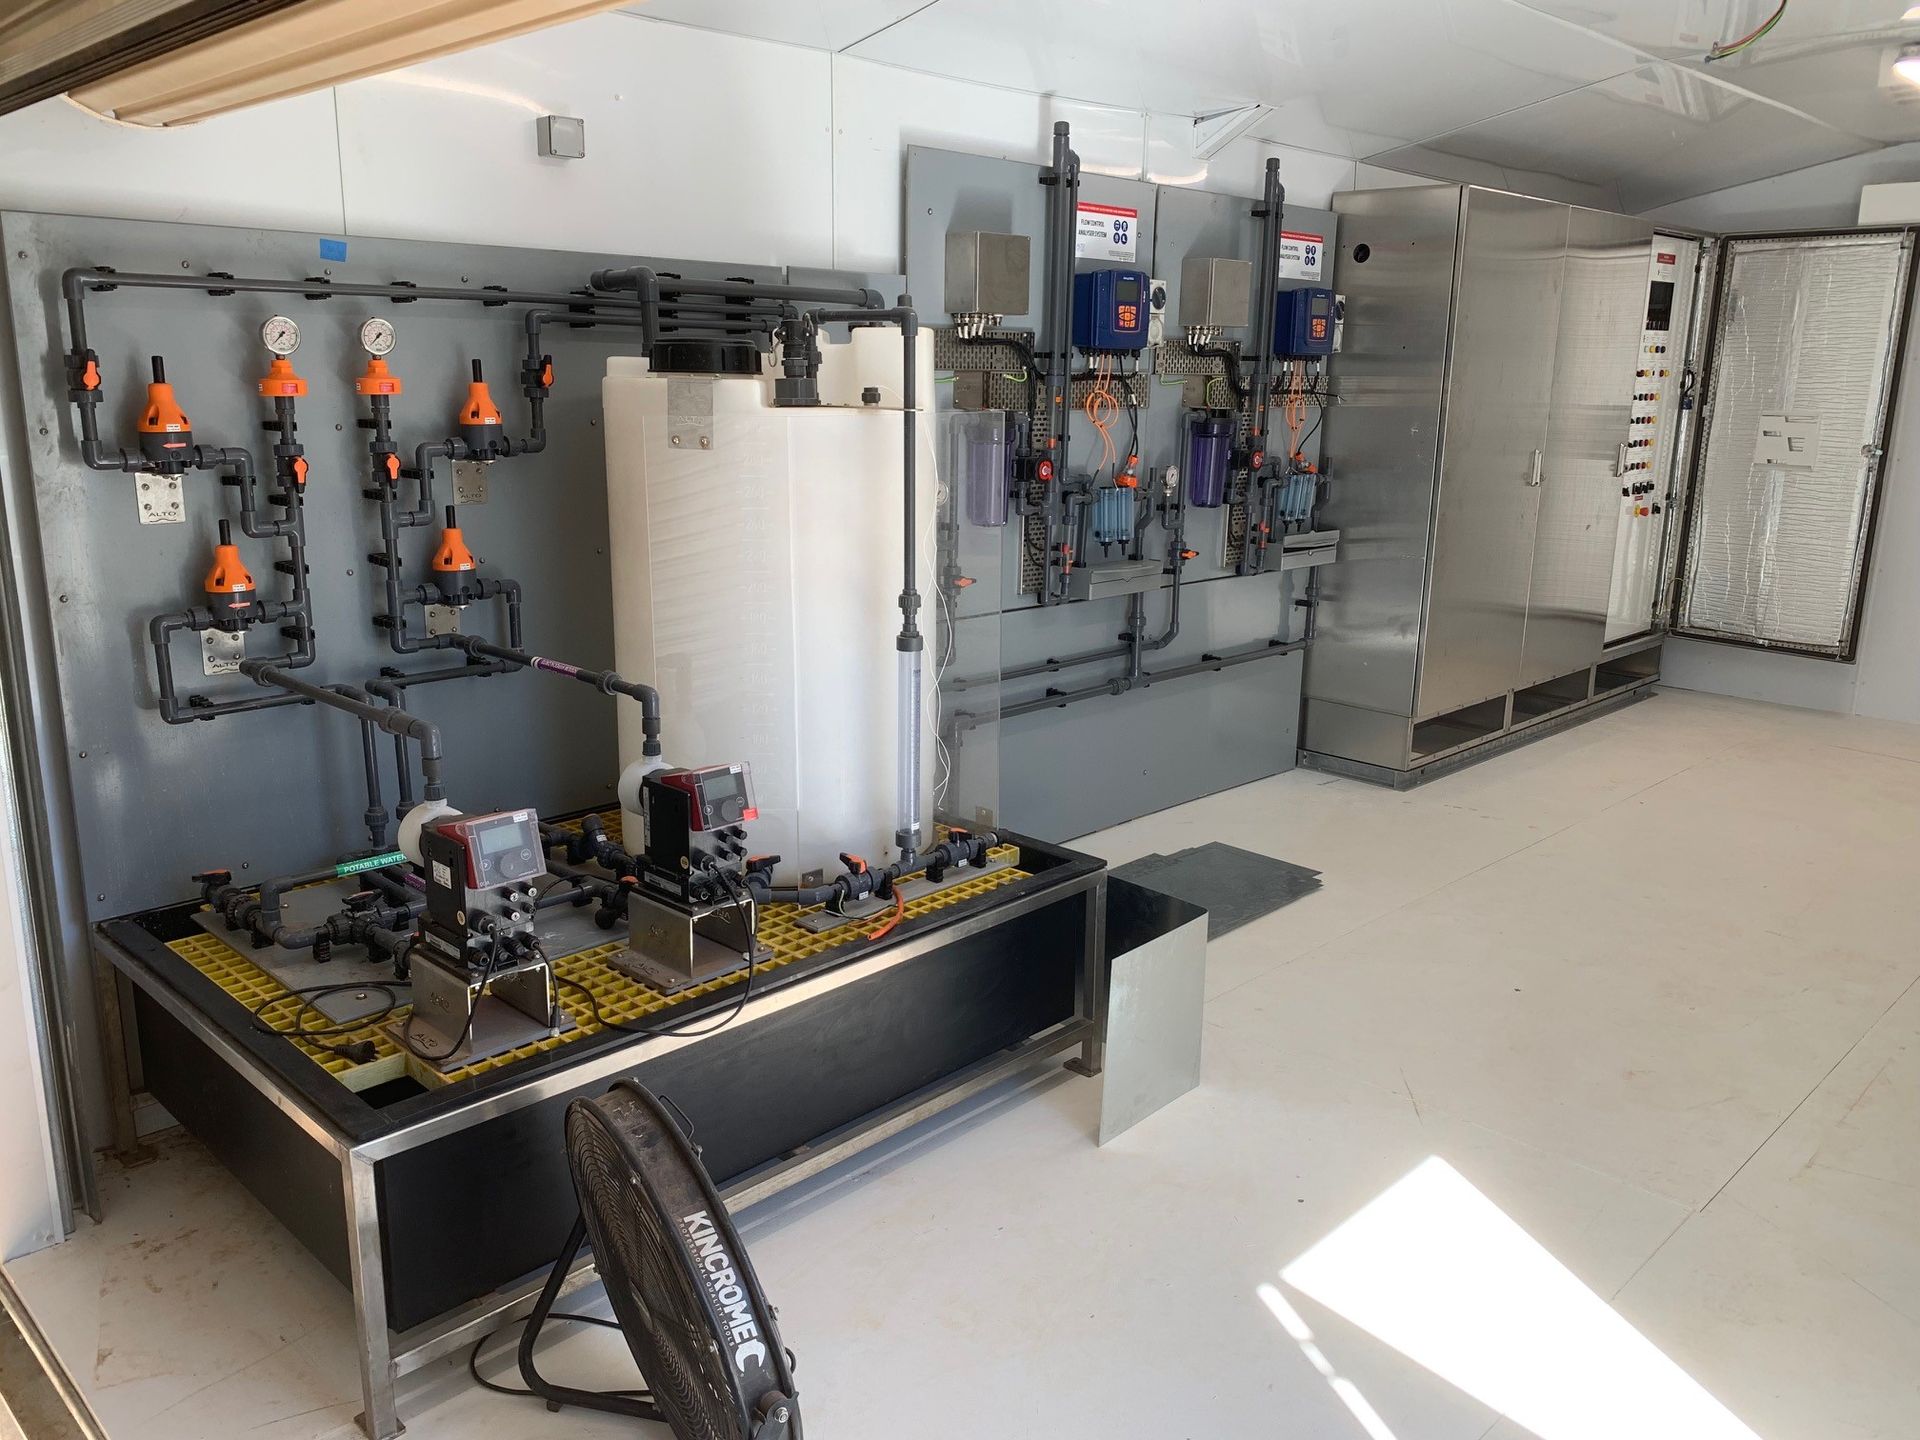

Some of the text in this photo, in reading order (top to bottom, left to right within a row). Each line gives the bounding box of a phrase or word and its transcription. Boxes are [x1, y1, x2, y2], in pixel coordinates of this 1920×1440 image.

[343, 859, 380, 873] POTABLE
[683, 1210, 758, 1344] KINCROME
[706, 1281, 725, 1317] QUALITY
[721, 1320, 735, 1347] TOOLS
